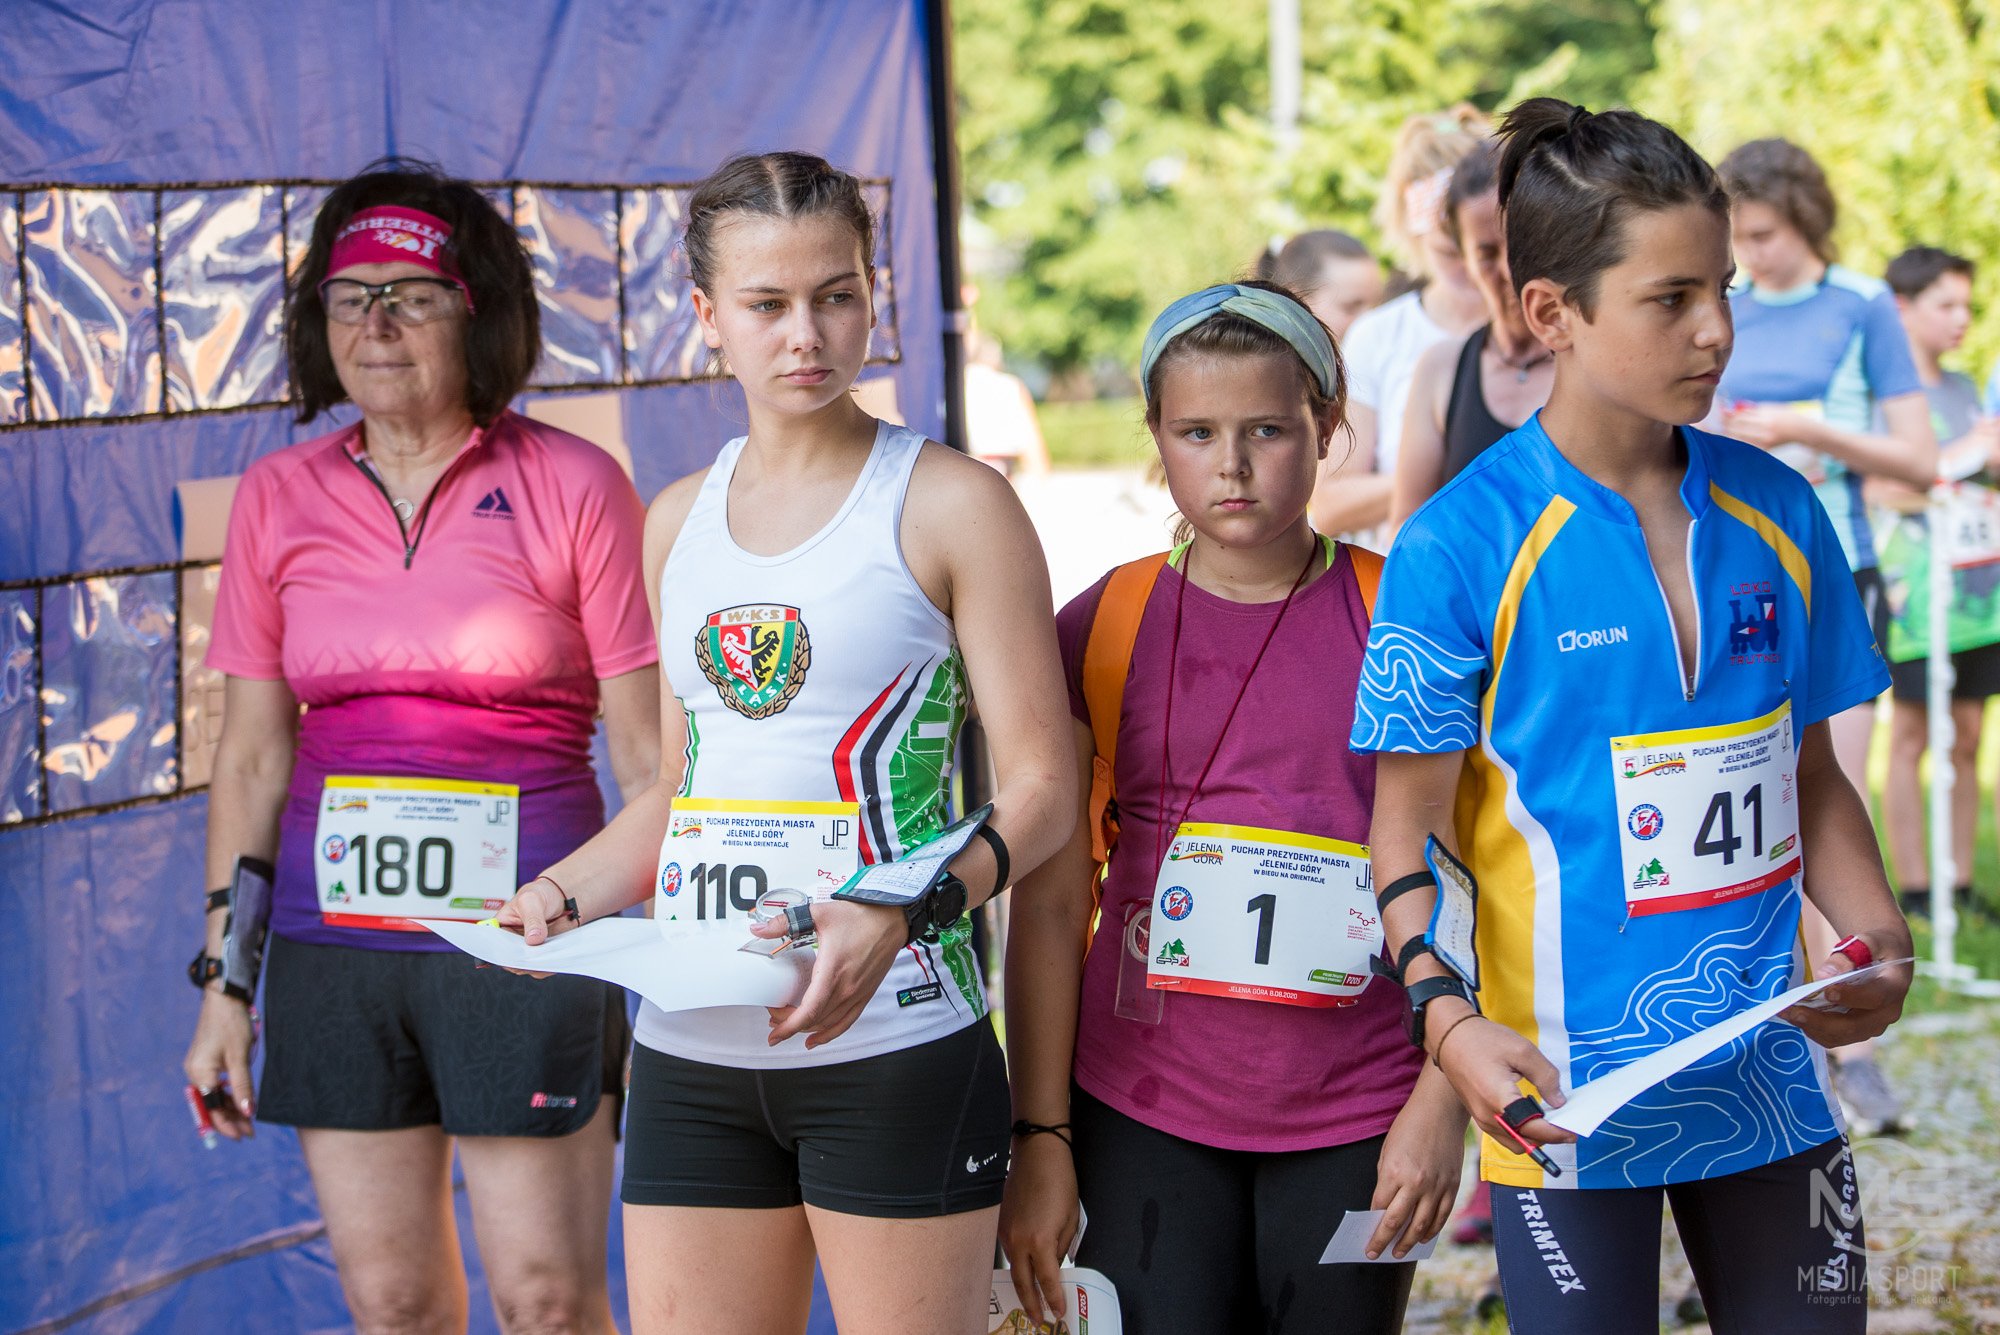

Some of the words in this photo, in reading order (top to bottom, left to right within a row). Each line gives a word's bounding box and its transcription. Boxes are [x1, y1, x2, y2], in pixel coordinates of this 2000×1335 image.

[1730, 581, 1771, 596] LOKO
[1692, 745, 1726, 757] PUCHAR
[1727, 735, 1767, 752] PREZYDENTA
[1642, 752, 1685, 767] JELENIA
[1723, 750, 1755, 764] JELENIEJ
[706, 817, 730, 826] PUCHAR
[731, 818, 781, 828] PREZYDENTA
[783, 820, 815, 829] MIASTA
[1693, 782, 1763, 866] 41
[726, 829, 761, 838] JELENIEJ
[762, 828, 785, 839] GÓRY
[822, 817, 849, 847] JP
[753, 841, 790, 849] ORIENTACJĘ
[1185, 842, 1224, 854] JELENIA
[1231, 845, 1265, 856] PUCHAR
[1267, 849, 1319, 864] PREZYDENTA
[1321, 856, 1350, 869] MIASTA
[350, 834, 454, 897] 180
[1259, 859, 1299, 871] JELENIEJ
[1300, 863, 1322, 875] GÓRY
[1261, 869, 1279, 877] BIEGU
[1289, 873, 1325, 885] ORIENTACJĘ
[1246, 893, 1277, 966] 1
[1228, 986, 1251, 994] JELENIA
[1252, 988, 1269, 996] GÓRA
[1516, 1189, 1587, 1295] TRIMTEX
